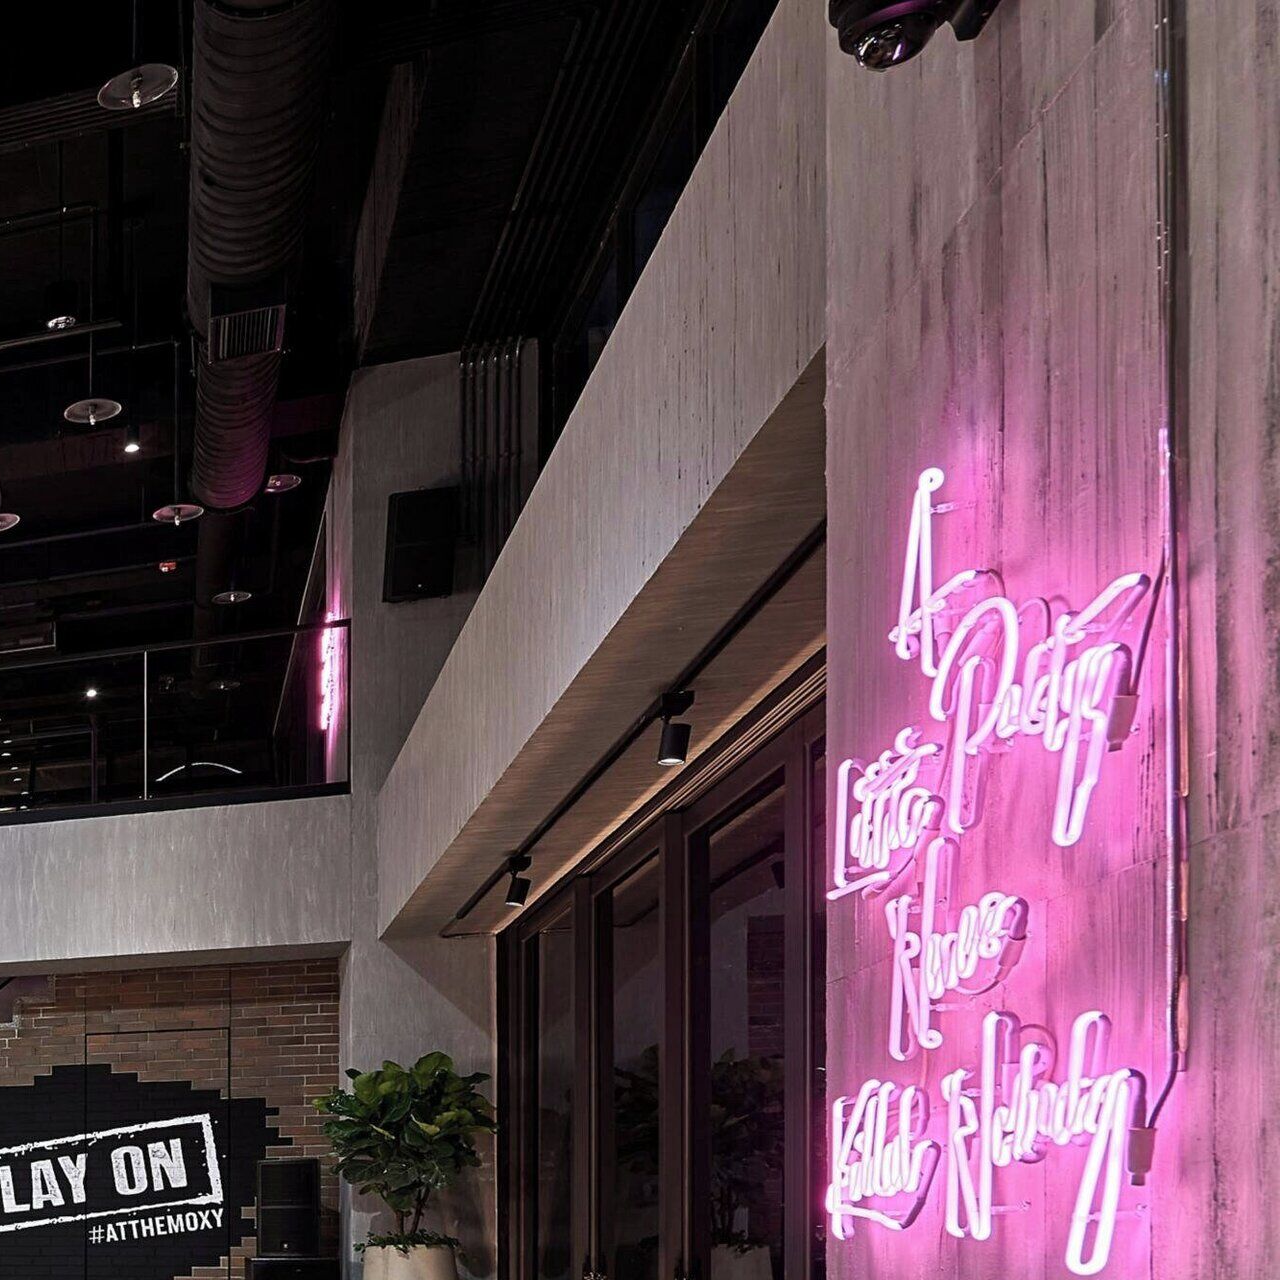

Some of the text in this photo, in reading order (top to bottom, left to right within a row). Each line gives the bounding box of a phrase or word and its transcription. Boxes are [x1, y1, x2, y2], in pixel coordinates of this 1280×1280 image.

[888, 466, 976, 678] A
[826, 572, 1150, 900] Little Party
[885, 837, 1028, 1061] Never
[88, 1207, 224, 1245] #ATTHEMOXY
[110, 1137, 188, 1195] ON
[941, 1010, 1136, 1276] Nobody
